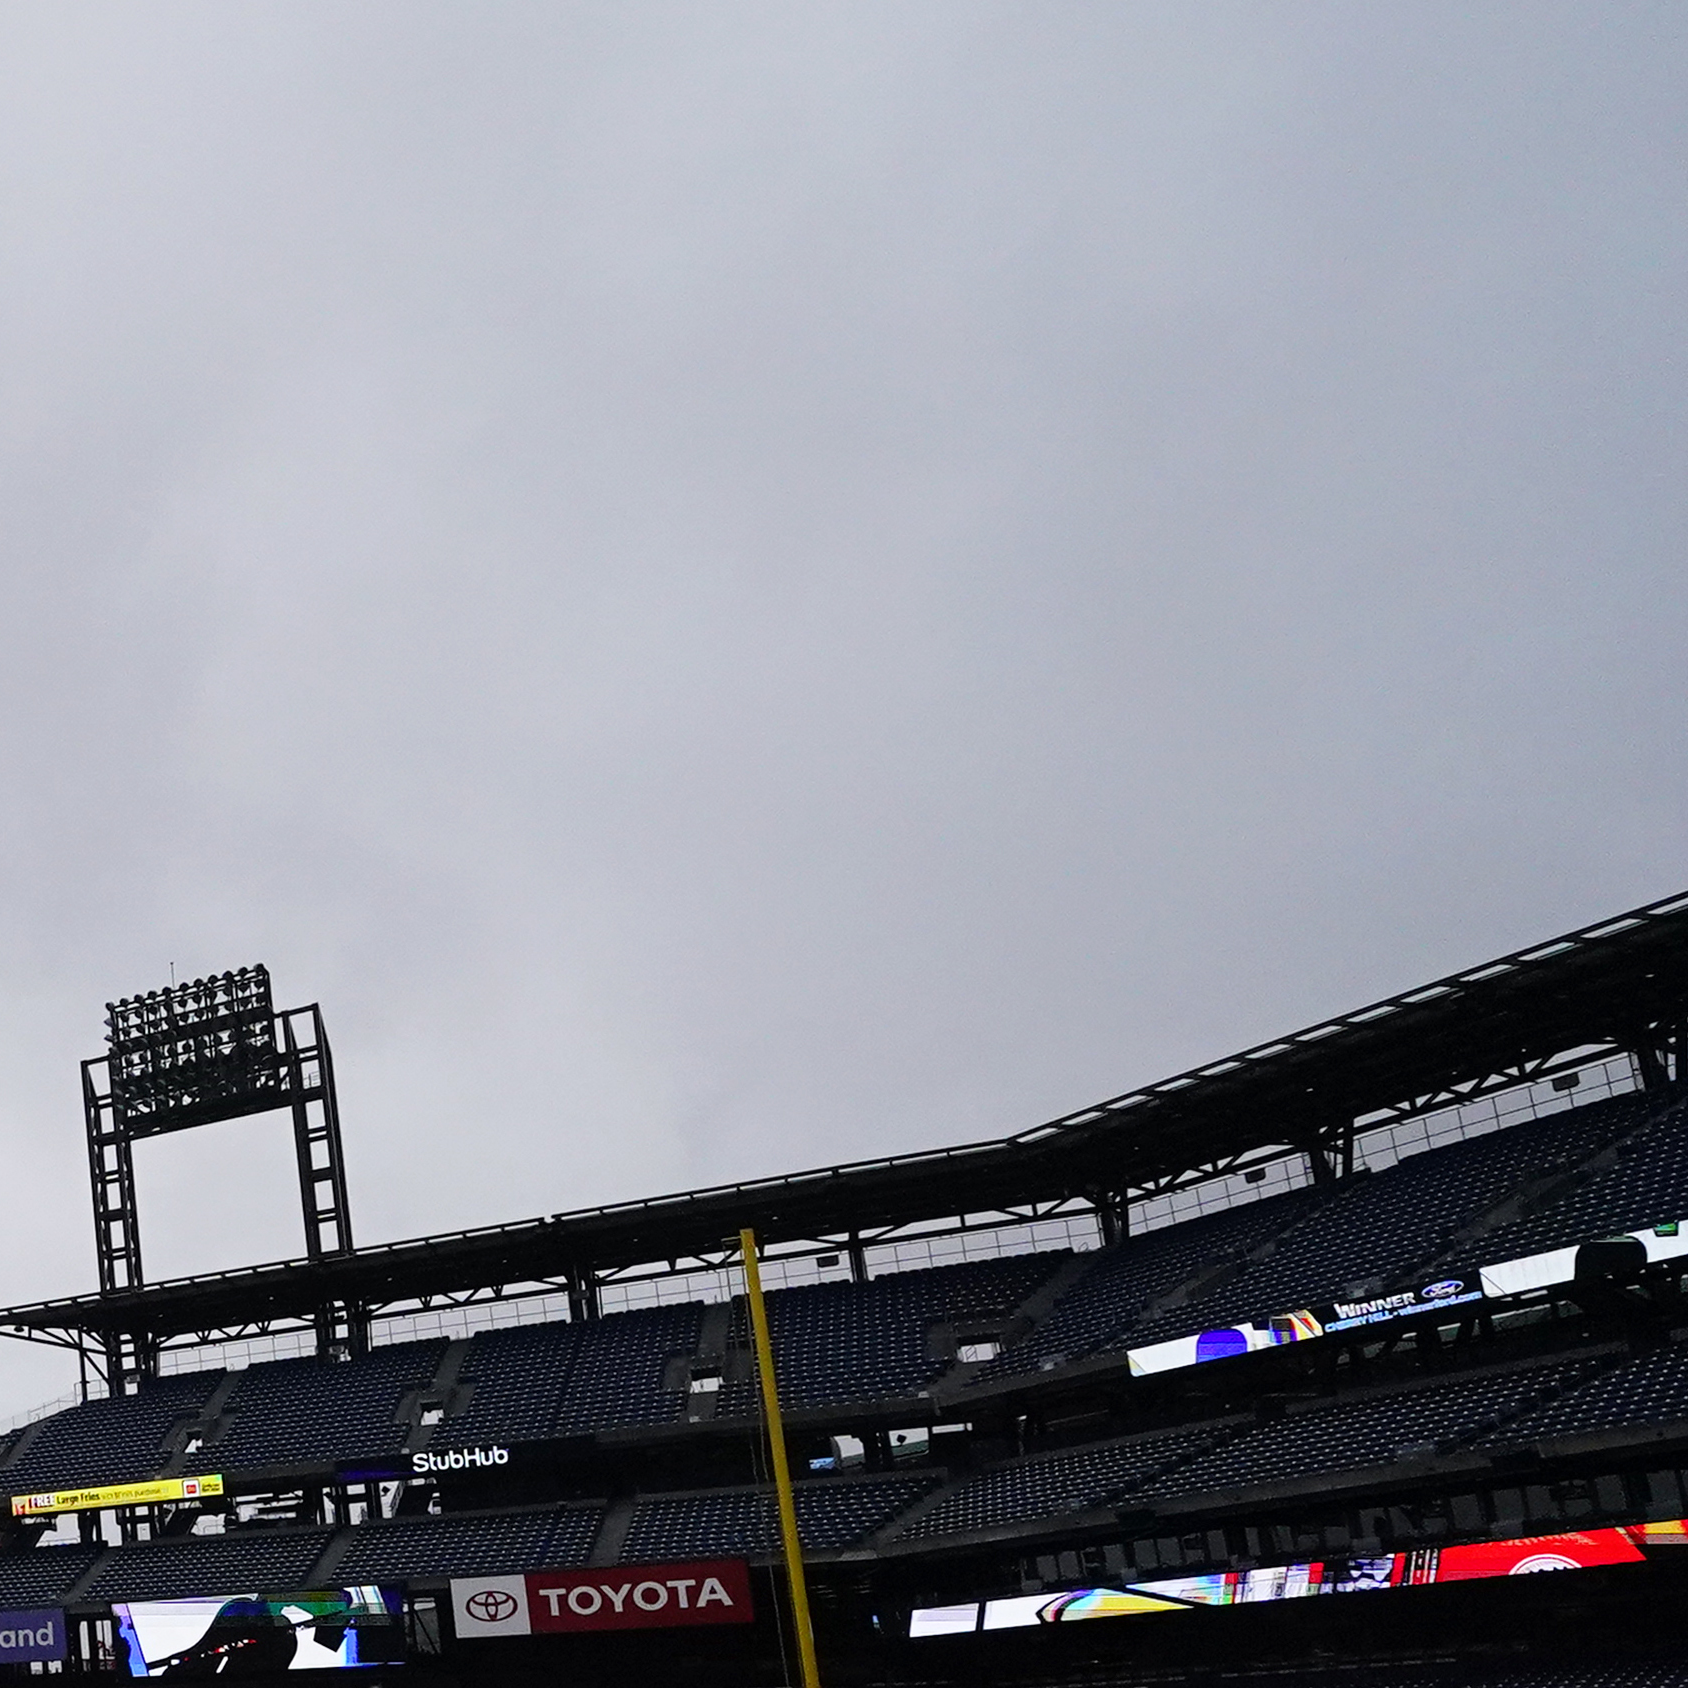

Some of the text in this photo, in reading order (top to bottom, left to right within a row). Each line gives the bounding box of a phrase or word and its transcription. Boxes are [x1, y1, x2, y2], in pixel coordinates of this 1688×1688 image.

[1333, 1292, 1417, 1320] WINNER
[412, 1445, 510, 1473] StubHub
[537, 1577, 734, 1617] TOYOTA
